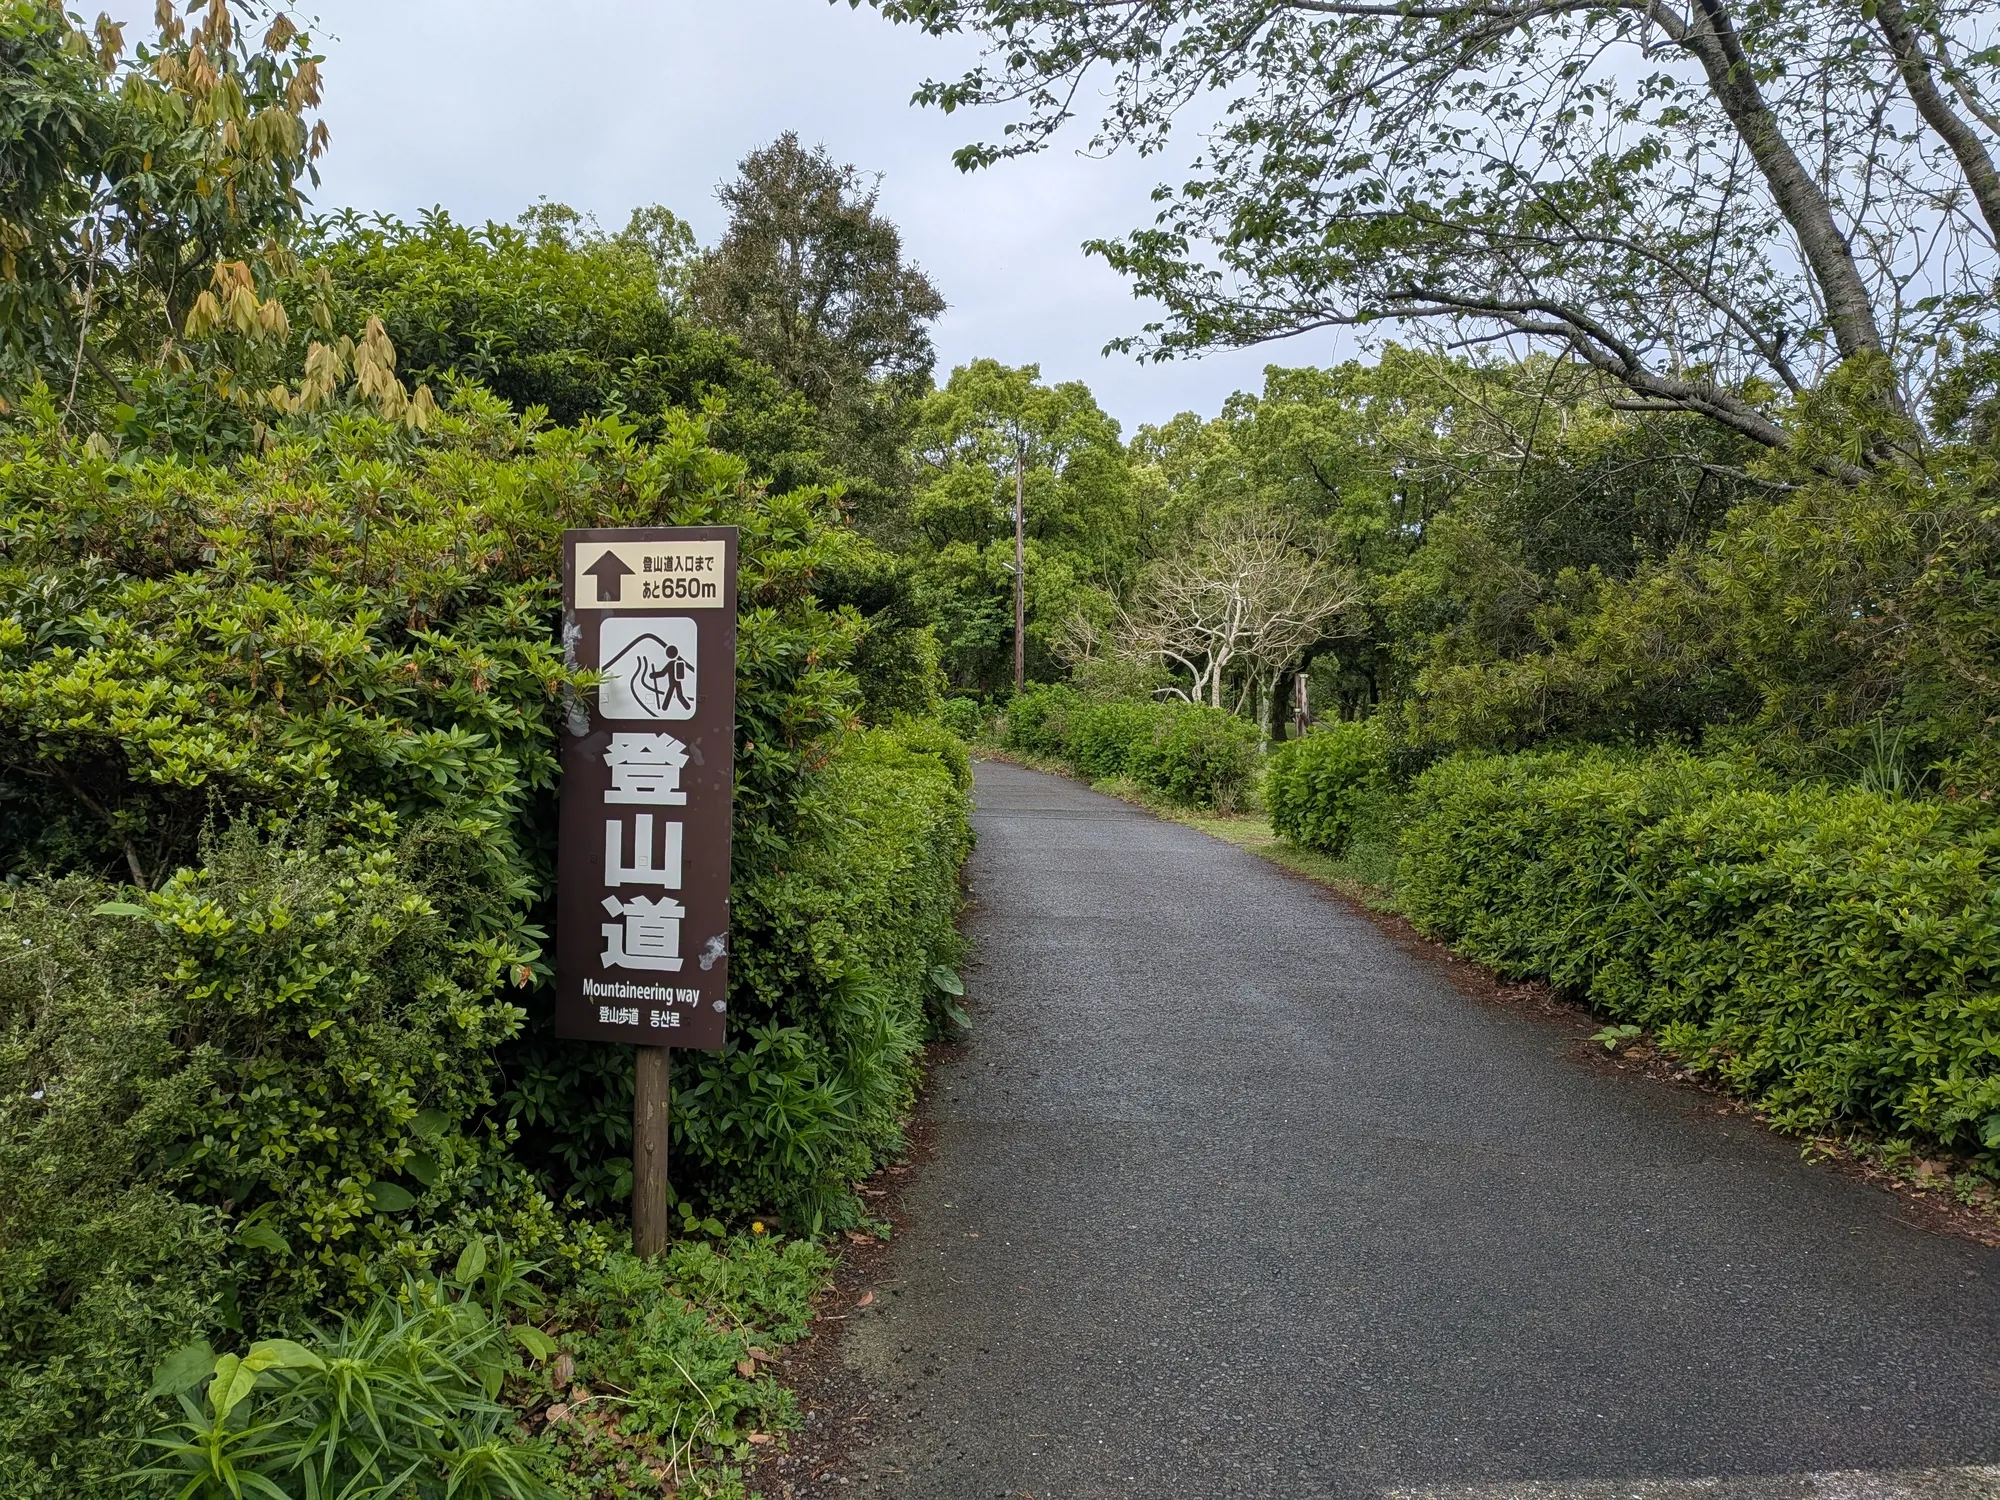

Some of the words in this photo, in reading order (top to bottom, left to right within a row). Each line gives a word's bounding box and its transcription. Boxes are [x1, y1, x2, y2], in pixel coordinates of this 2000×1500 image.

[642, 555, 714, 573] 登山道入口まで
[642, 577, 717, 599] あと650m
[600, 732, 690, 972] 登山道
[582, 978, 674, 1006] Mountaineering
[676, 987, 700, 1008] way
[599, 1005, 640, 1026] 登山歩道
[649, 1009, 681, 1028] 등산로
